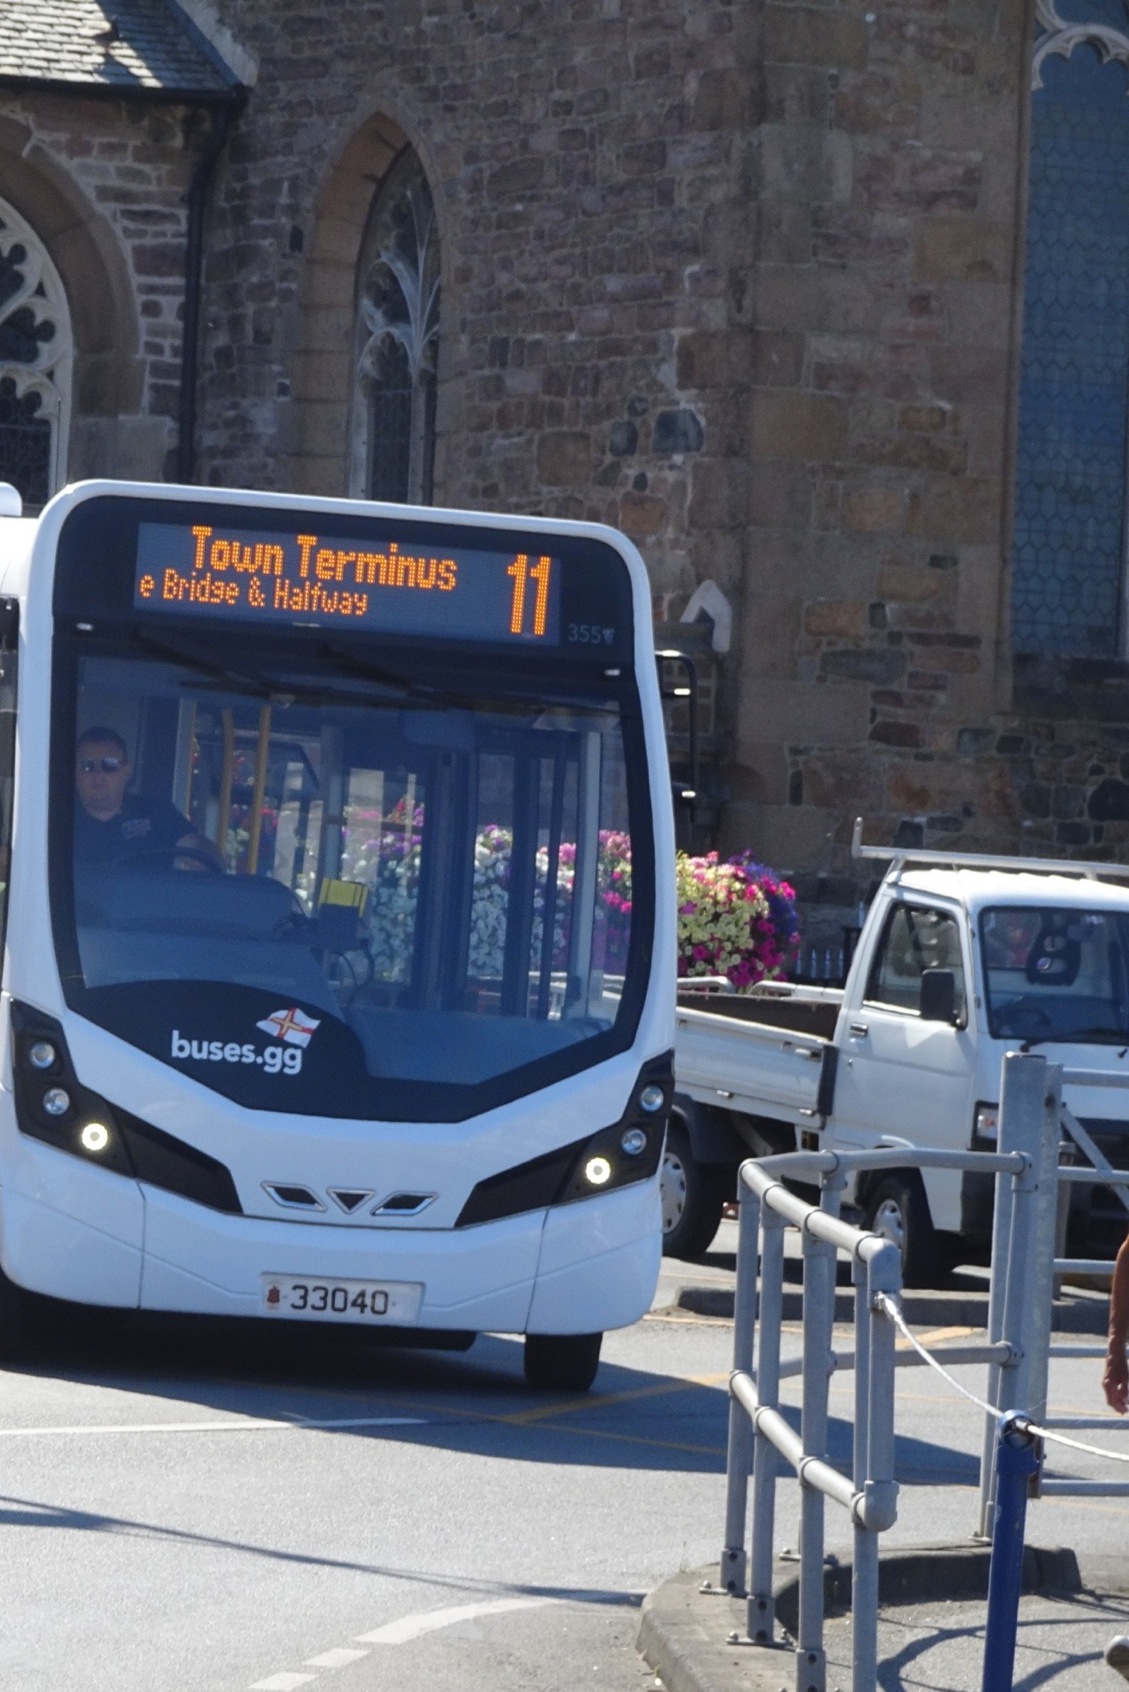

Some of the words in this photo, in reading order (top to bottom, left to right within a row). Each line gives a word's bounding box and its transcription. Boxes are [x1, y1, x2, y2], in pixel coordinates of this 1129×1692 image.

[191, 525, 284, 575] Town
[296, 534, 457, 590] Terminus
[163, 568, 240, 605] Bridge
[248, 575, 266, 607] &
[274, 577, 369, 616] Halfway
[507, 553, 551, 635] 11
[171, 1029, 303, 1075] buses.gg
[290, 1284, 389, 1315] 33040
